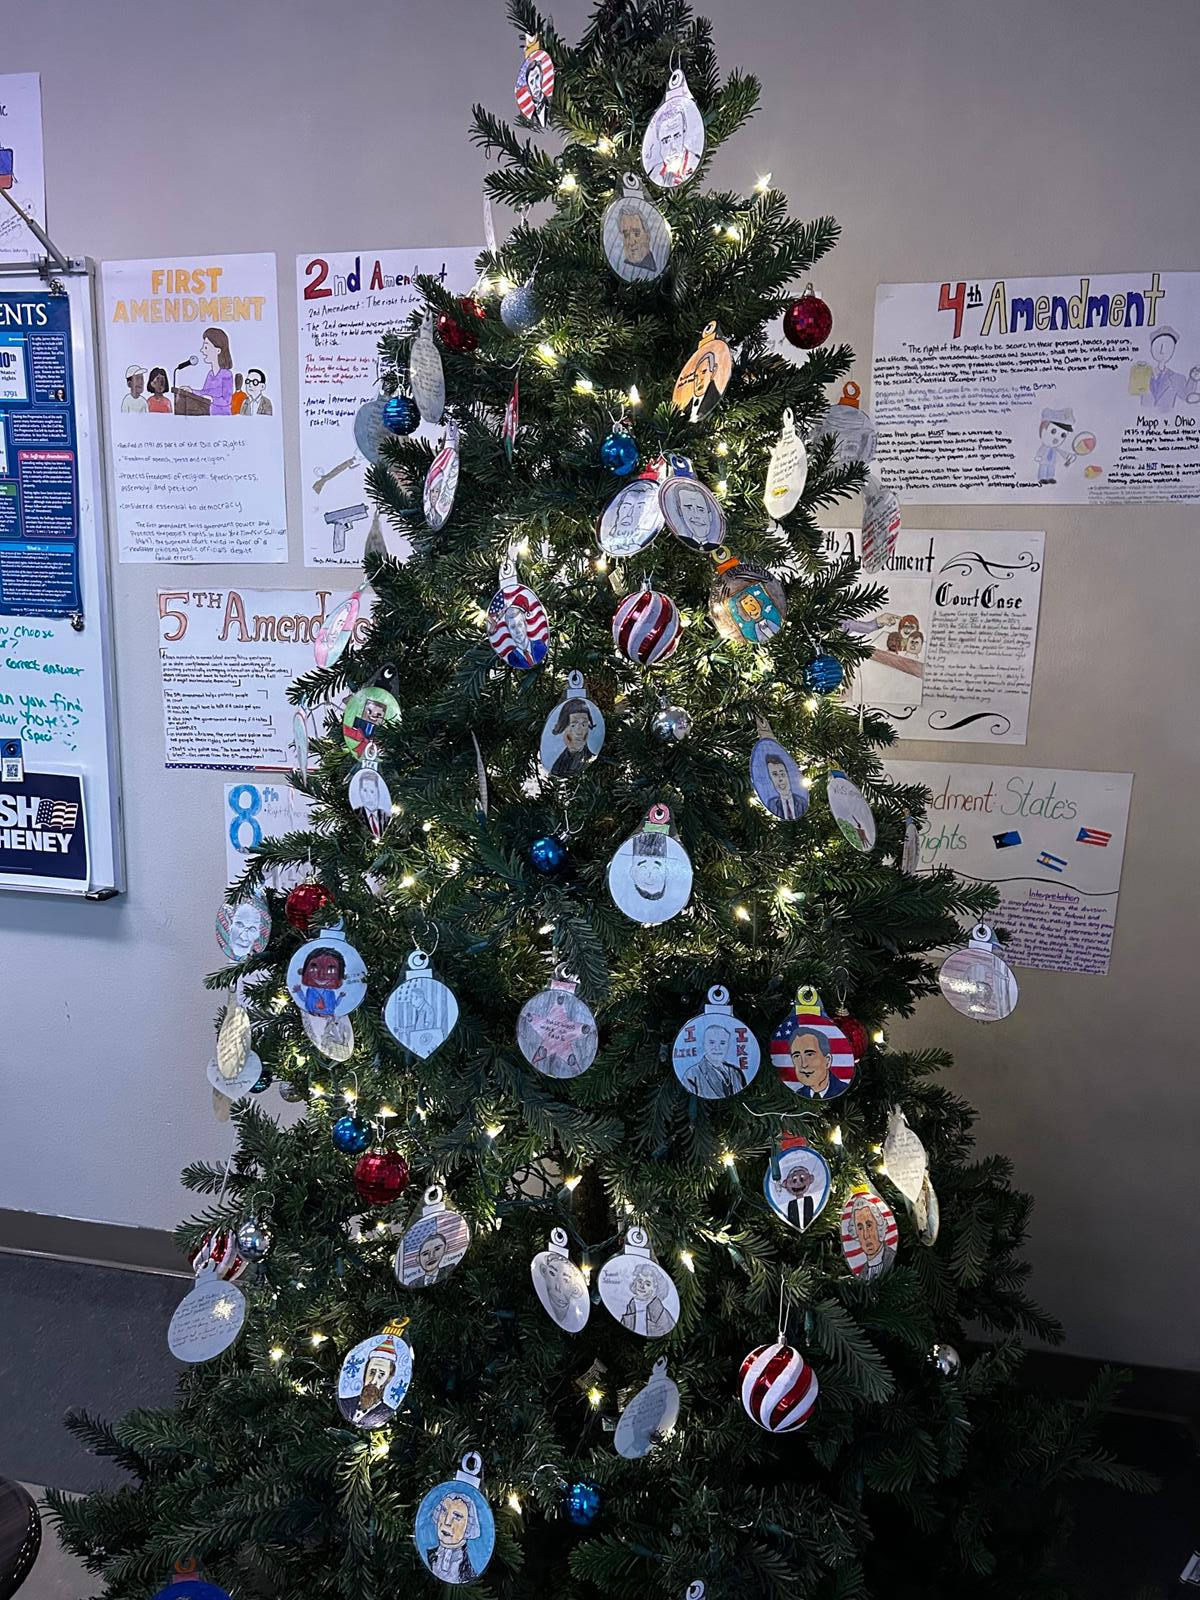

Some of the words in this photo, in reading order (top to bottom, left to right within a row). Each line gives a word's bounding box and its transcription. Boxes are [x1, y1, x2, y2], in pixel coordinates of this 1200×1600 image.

[151, 266, 223, 295] FIRST
[304, 255, 361, 300] 2nd
[112, 296, 266, 323] AMENDMENT
[366, 296, 381, 308] The
[938, 283, 984, 339] 4th
[980, 273, 1165, 336] Amendment
[0, 303, 48, 326] NTS
[923, 345, 939, 356] right
[940, 343, 947, 351] of
[950, 343, 961, 352] the
[964, 343, 984, 353] people
[1136, 414, 1159, 430] Mapp
[1174, 414, 1196, 428] Ohio
[199, 501, 242, 513] democracy
[825, 531, 840, 553] th
[935, 581, 979, 607] Court
[981, 583, 1022, 609] Case
[159, 592, 224, 641] 5TH
[13, 625, 54, 639] choose
[5, 657, 40, 671] correct
[19, 695, 47, 712] you
[1028, 887, 1080, 903] Interpretation
[684, 1024, 696, 1043] I
